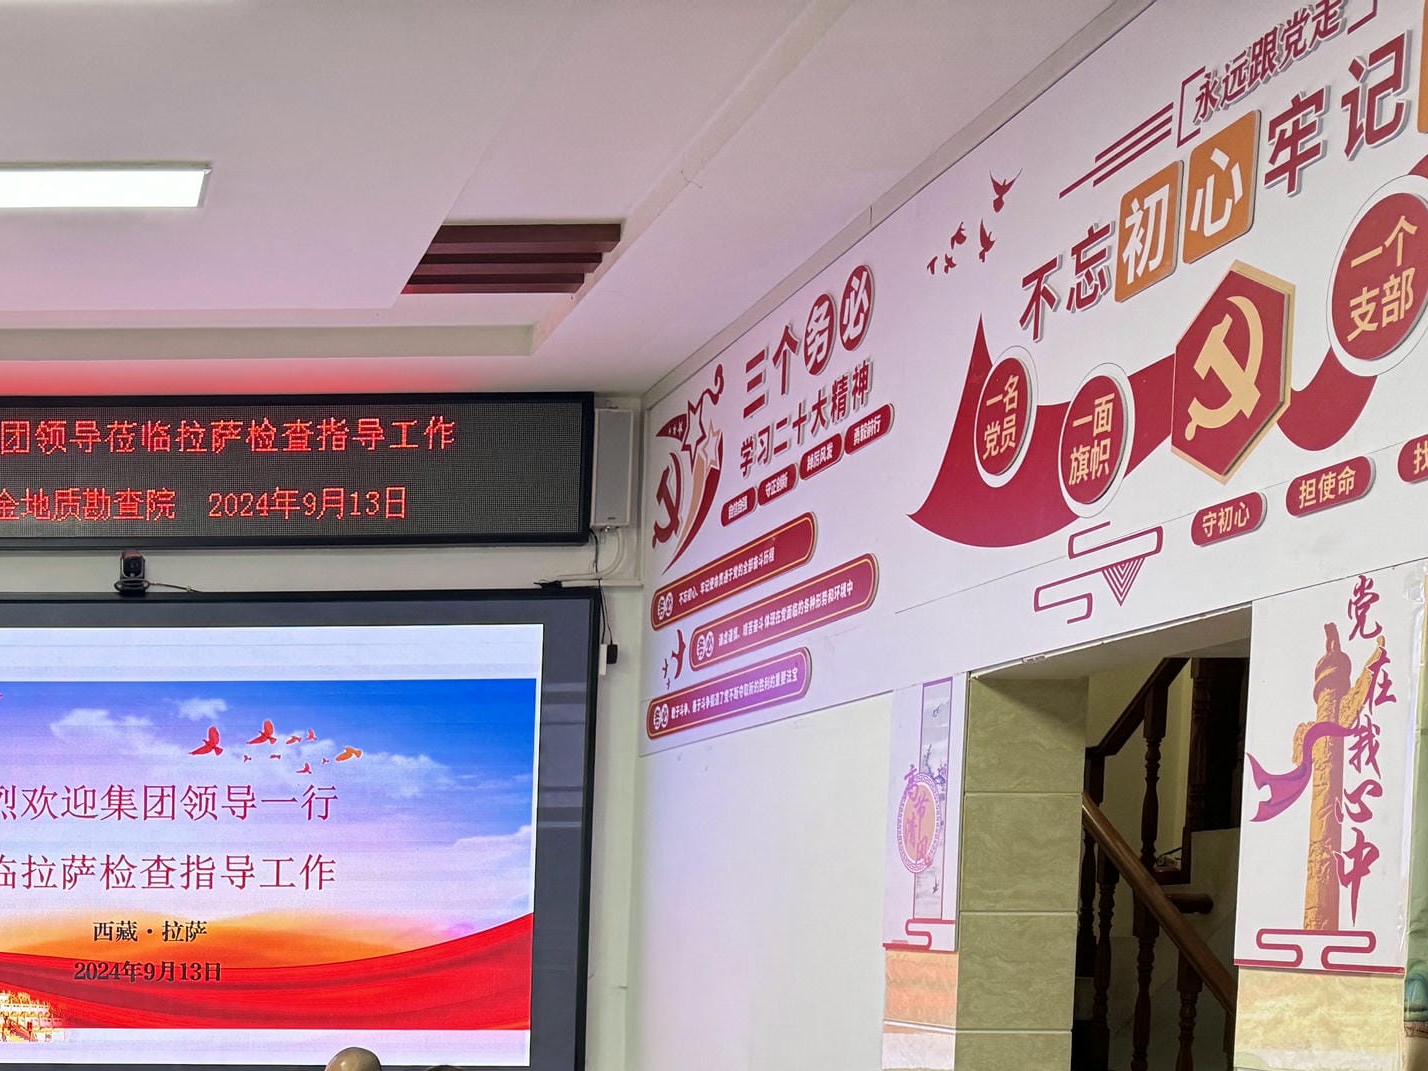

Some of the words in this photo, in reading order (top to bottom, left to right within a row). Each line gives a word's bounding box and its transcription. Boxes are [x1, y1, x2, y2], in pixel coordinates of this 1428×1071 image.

[1193, 0, 1342, 123] 永远跟党走
[1350, 215, 1418, 270] 一个
[1347, 266, 1416, 342] 支部
[743, 270, 870, 419] 三个务必
[986, 374, 1019, 413] 一名
[1072, 393, 1115, 437] 一面
[740, 360, 870, 477] 学习二十大精神
[983, 414, 1016, 461] 党员
[1068, 438, 1111, 486] 旗帜
[208, 487, 408, 520] 2024年9月13日
[1299, 466, 1356, 509] 担使命
[1202, 501, 1250, 538] 守初心
[1335, 575, 1397, 927] 党在我心中
[74, 960, 222, 982] 2024年9月13日
